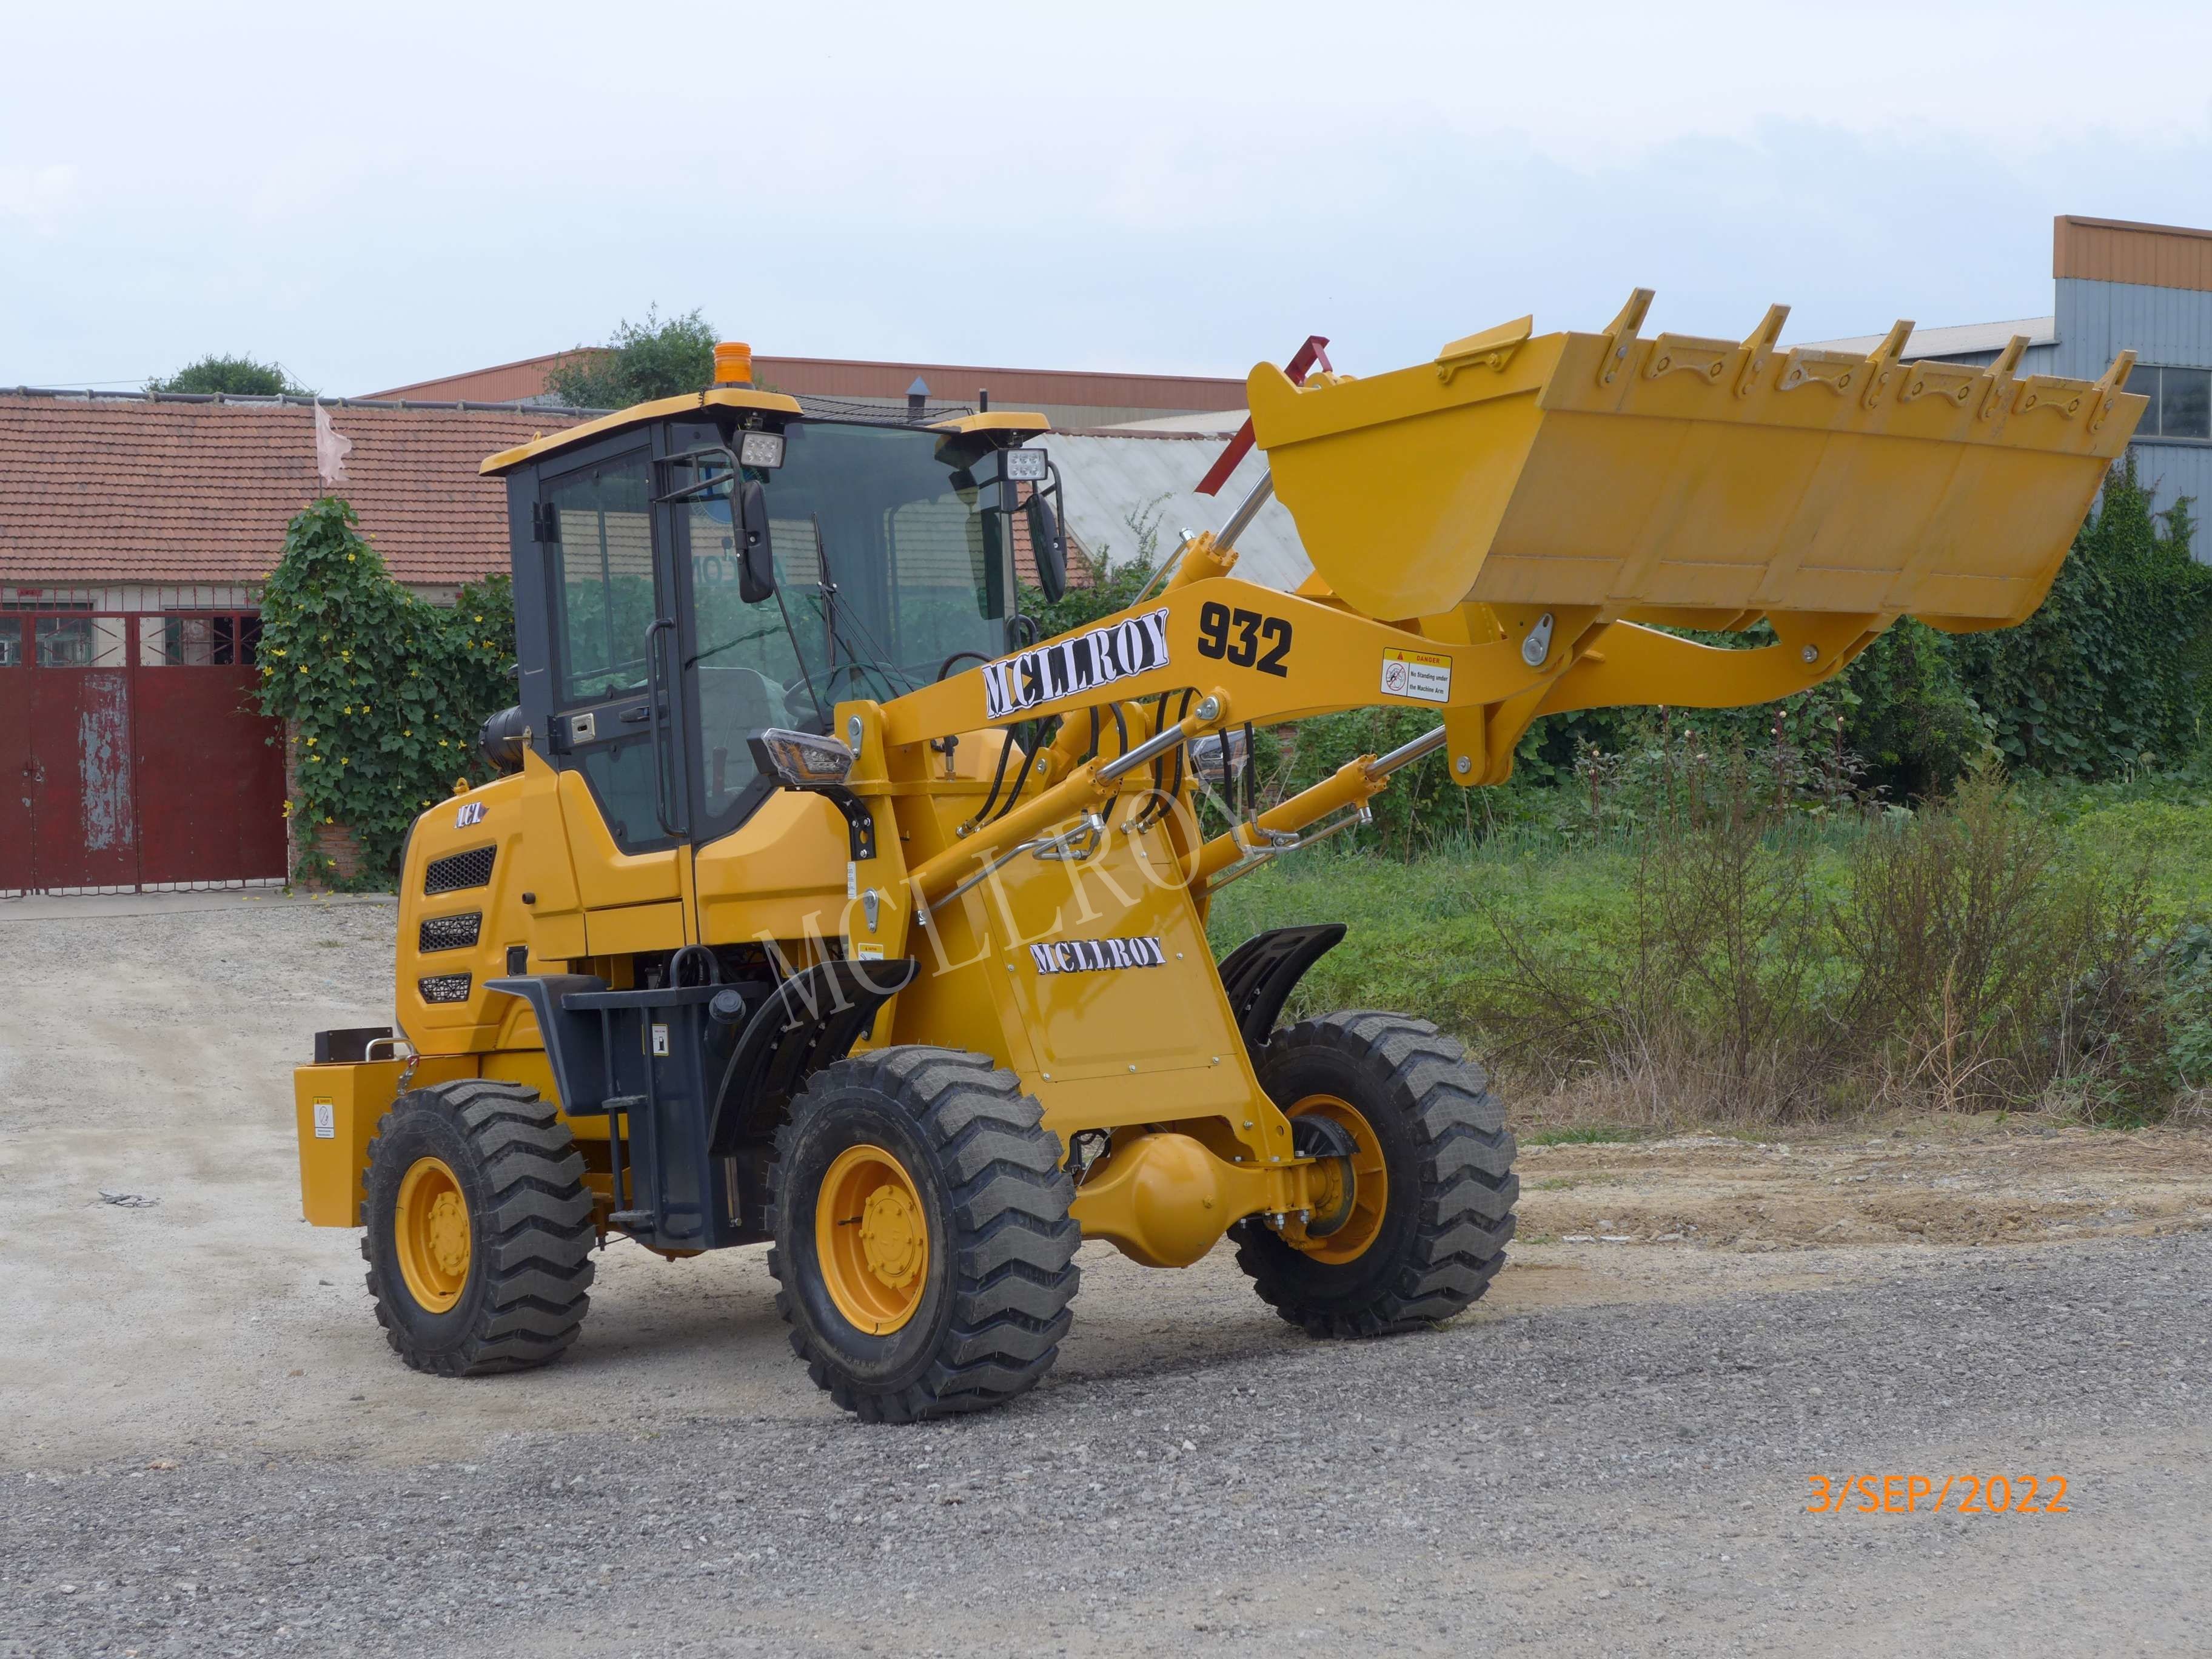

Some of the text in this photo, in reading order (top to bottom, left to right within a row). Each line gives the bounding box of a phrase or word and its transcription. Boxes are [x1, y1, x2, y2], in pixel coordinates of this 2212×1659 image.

[982, 609, 1168, 717] MCLLROY
[1198, 602, 1292, 678] 932
[1417, 672, 1435, 681] Standing
[1030, 937, 1166, 974] MCLLROY
